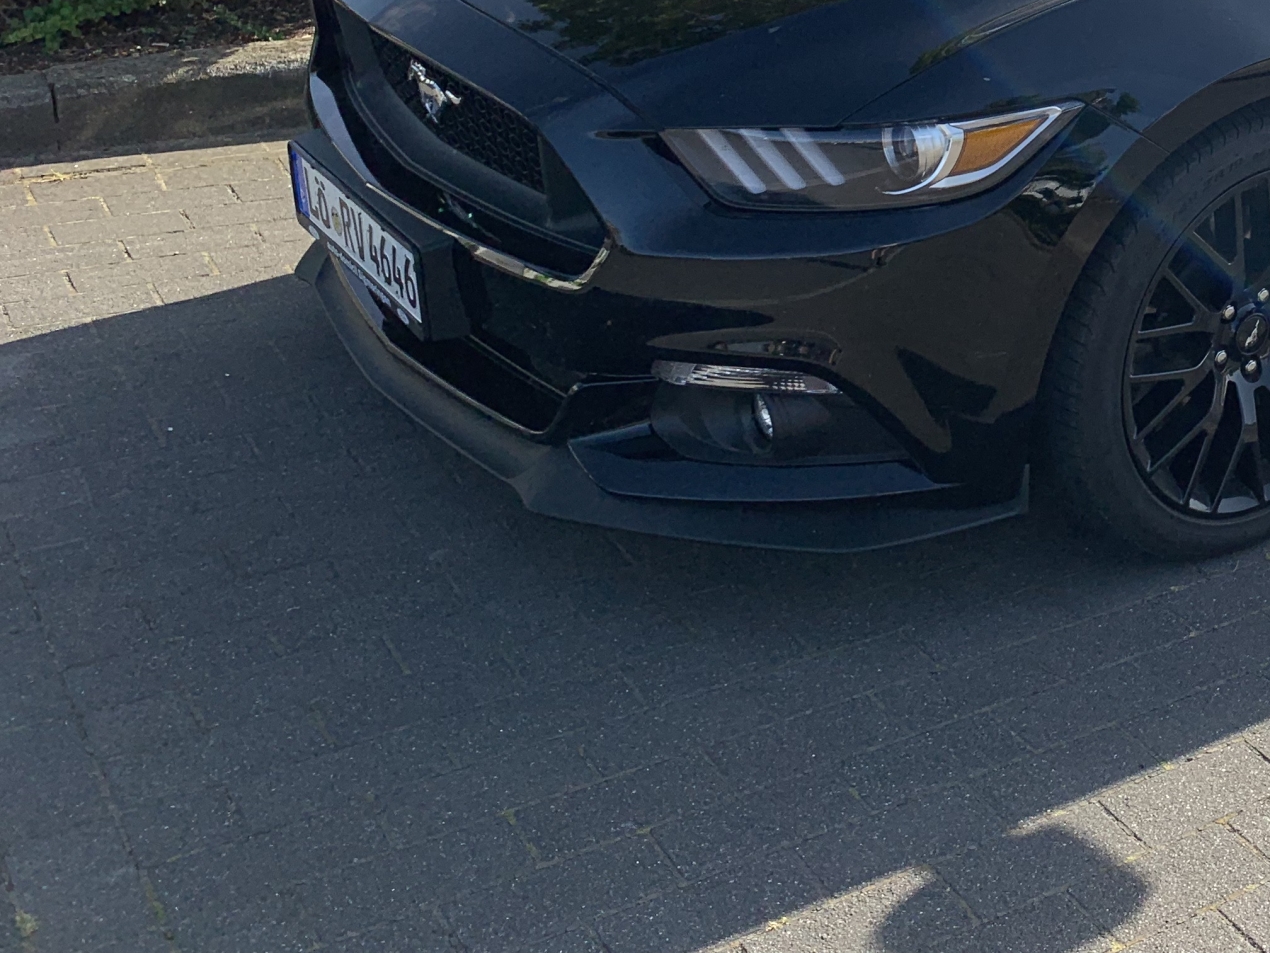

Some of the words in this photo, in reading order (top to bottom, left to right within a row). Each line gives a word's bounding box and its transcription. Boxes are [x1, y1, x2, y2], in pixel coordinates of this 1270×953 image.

[304, 166, 331, 229] LÖ
[339, 196, 365, 262] RV
[368, 224, 418, 309] 4646
